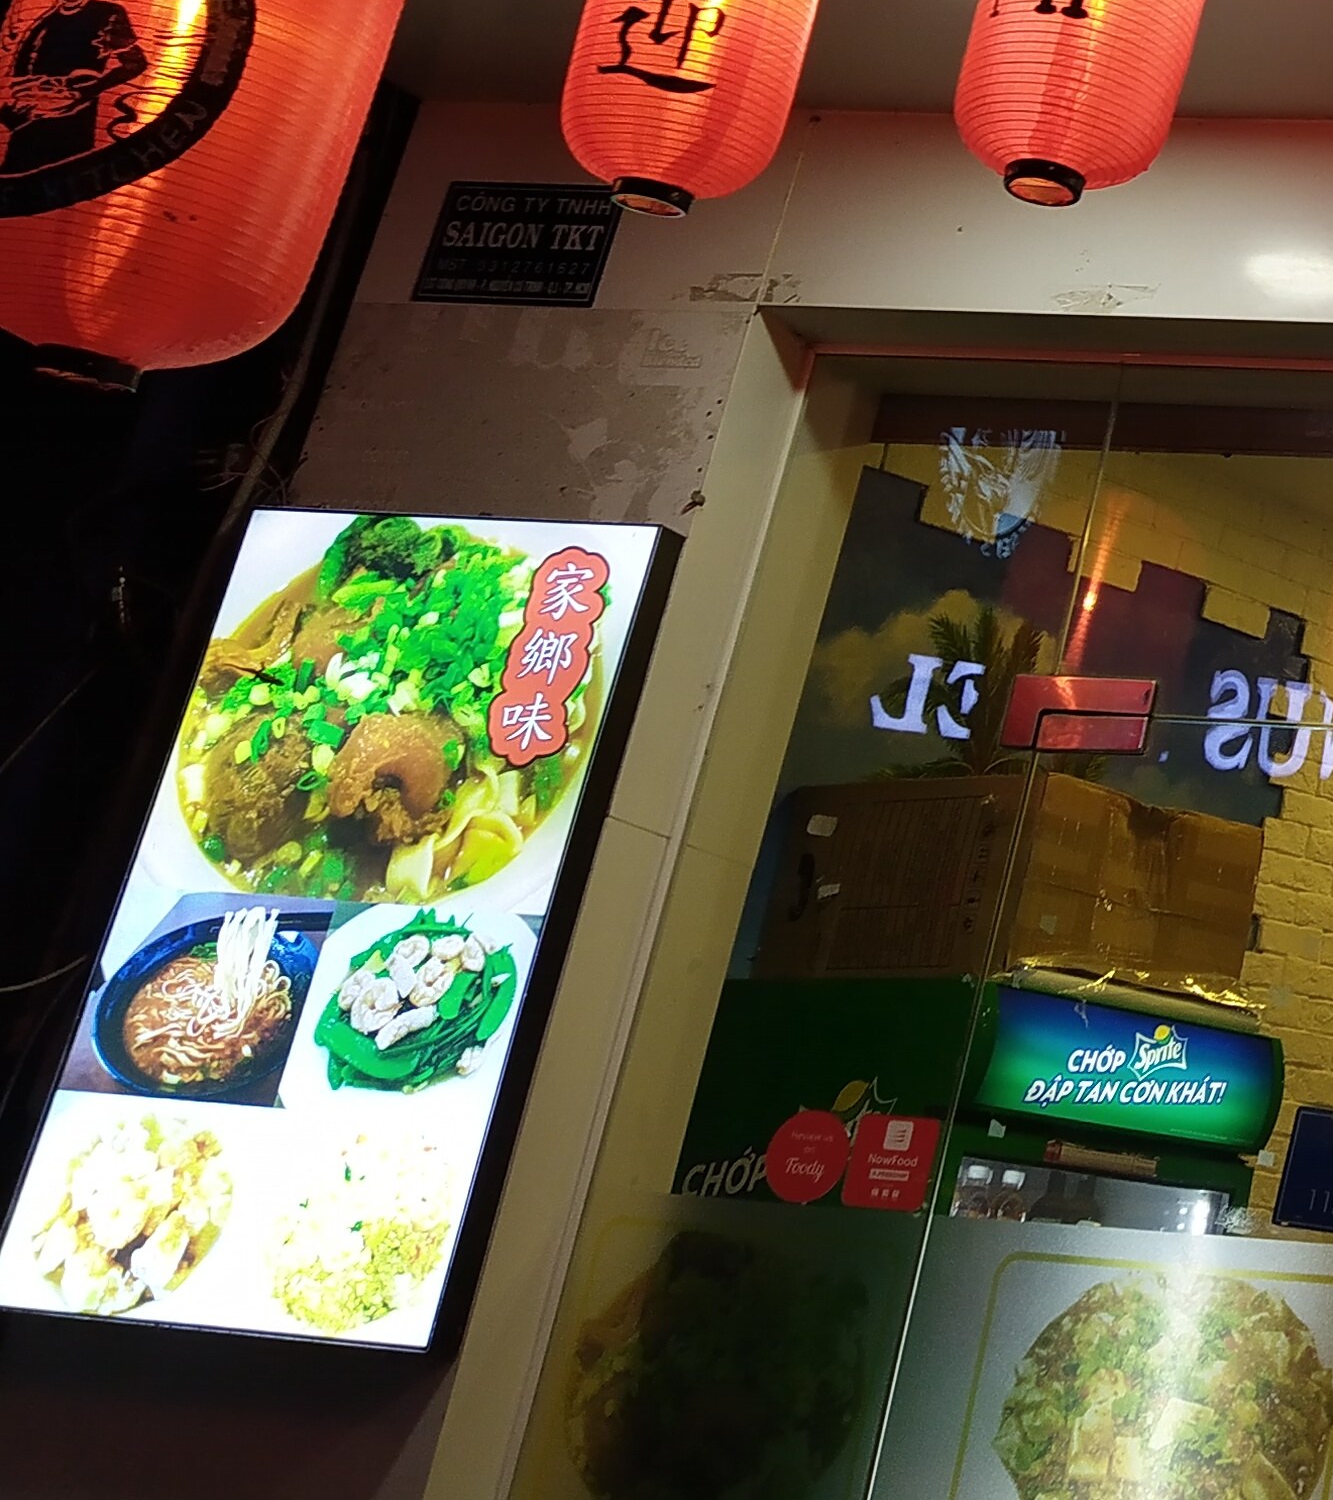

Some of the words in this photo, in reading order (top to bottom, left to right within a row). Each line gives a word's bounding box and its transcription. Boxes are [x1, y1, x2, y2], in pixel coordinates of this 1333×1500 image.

[524, 197, 548, 214] TY
[556, 197, 612, 216] TNHH
[442, 221, 545, 249] SAIGON
[551, 224, 605, 251] TKT
[501, 560, 595, 751] 家鄉味
[1068, 1044, 1127, 1073] CHỚP
[1136, 1038, 1184, 1072] Sprite
[1024, 1075, 1075, 1108] ĐẬP
[1076, 1080, 1119, 1104] TAN
[1119, 1079, 1170, 1104] CƠN
[1170, 1073, 1228, 1105] KHÁT!
[785, 1157, 826, 1184] Foody
[868, 1153, 920, 1168] NowFood
